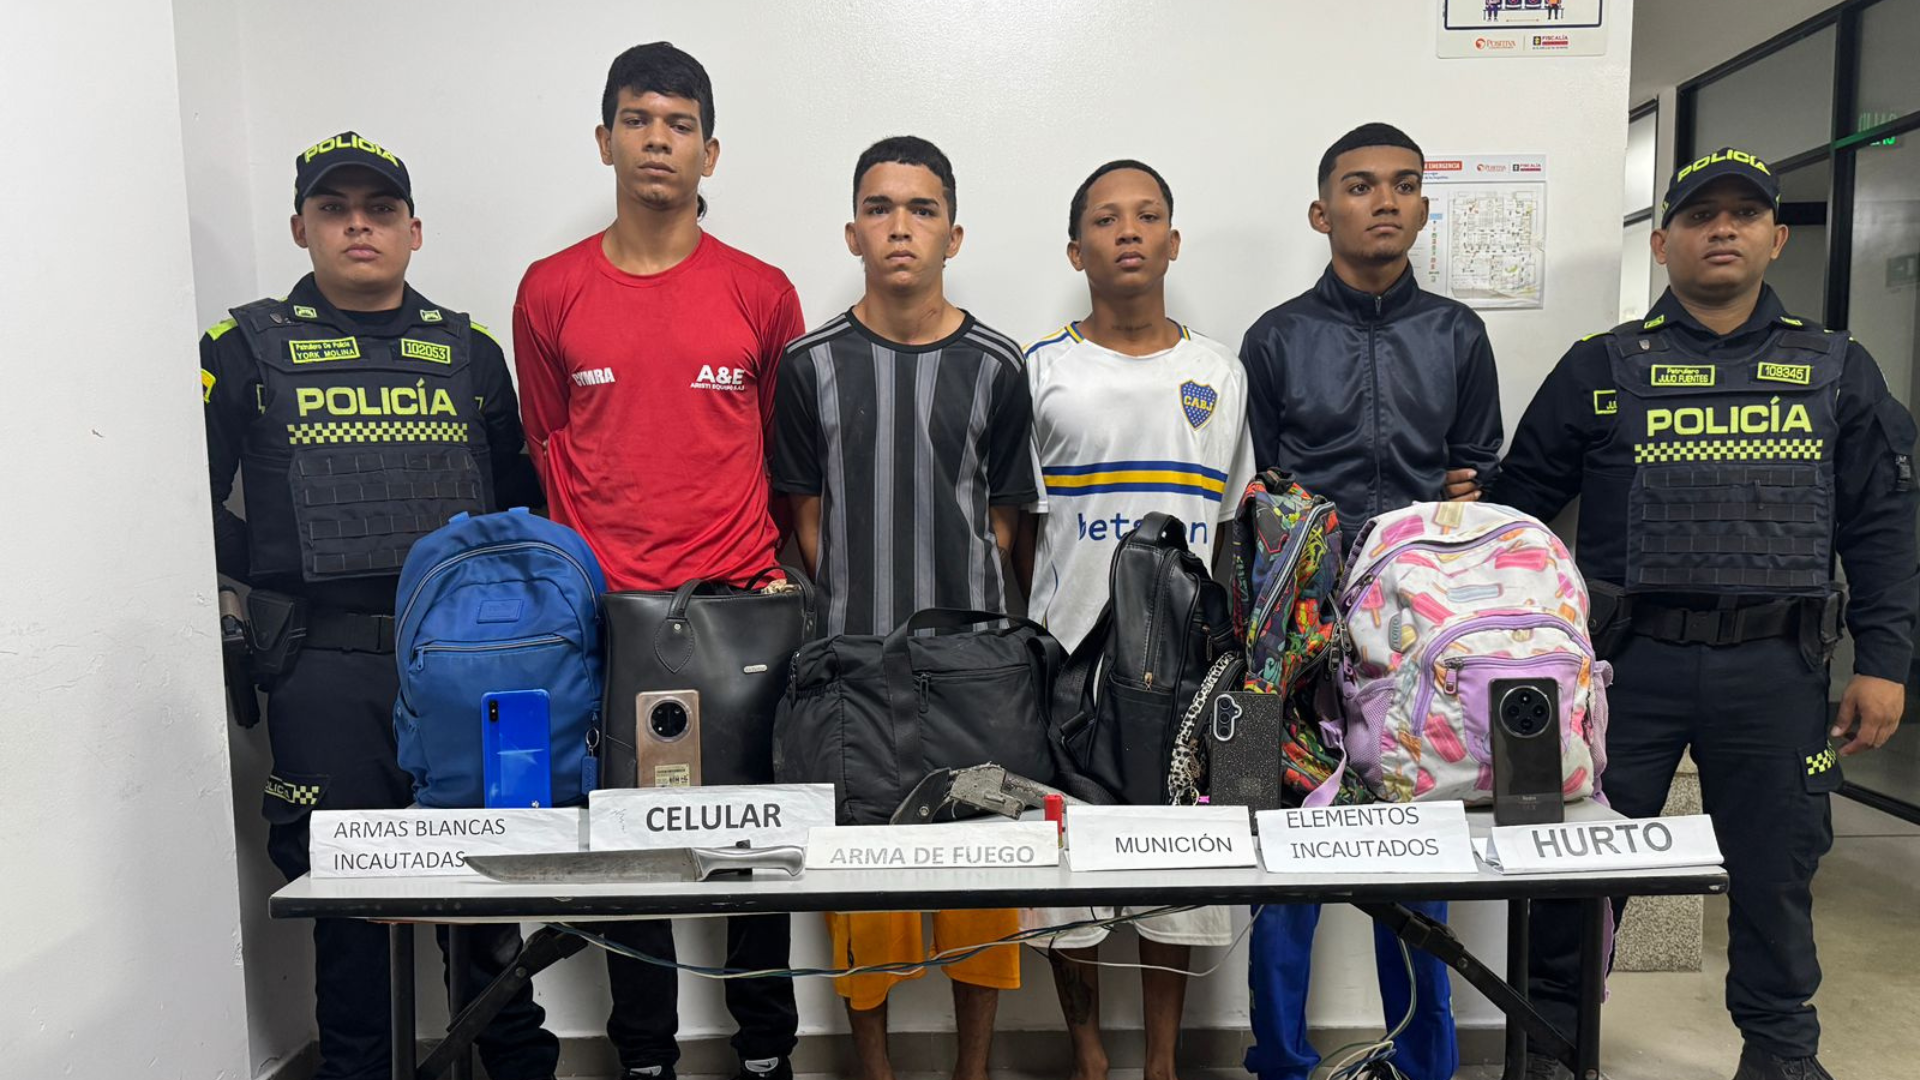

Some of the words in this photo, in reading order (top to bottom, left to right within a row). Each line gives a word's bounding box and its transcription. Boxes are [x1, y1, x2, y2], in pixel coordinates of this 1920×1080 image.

[297, 351, 320, 360] YORK
[324, 347, 355, 358] MOLINA
[406, 342, 446, 360] 102053
[696, 364, 745, 385] A&E
[1658, 374, 1677, 383] JULIO
[1678, 374, 1709, 383] FUENTES
[296, 378, 457, 416] POLICÍA
[1183, 395, 1214, 412] CABJ
[1647, 396, 1813, 436] POLICÍA
[1078, 512, 1208, 544] betn
[646, 803, 782, 832] CELULAR
[1286, 806, 1420, 829] ELEMENTOS
[333, 821, 409, 839] ARMAS
[415, 818, 506, 837] BLANCAS
[1114, 833, 1232, 854] MUNICIÓN
[1291, 838, 1440, 860] INCAUTADOS
[1531, 821, 1674, 858] HURTO
[334, 850, 466, 871] INCAUTADAS
[830, 846, 905, 865] ARMA
[914, 846, 944, 865] DE
[952, 845, 1036, 864] FUEGO
